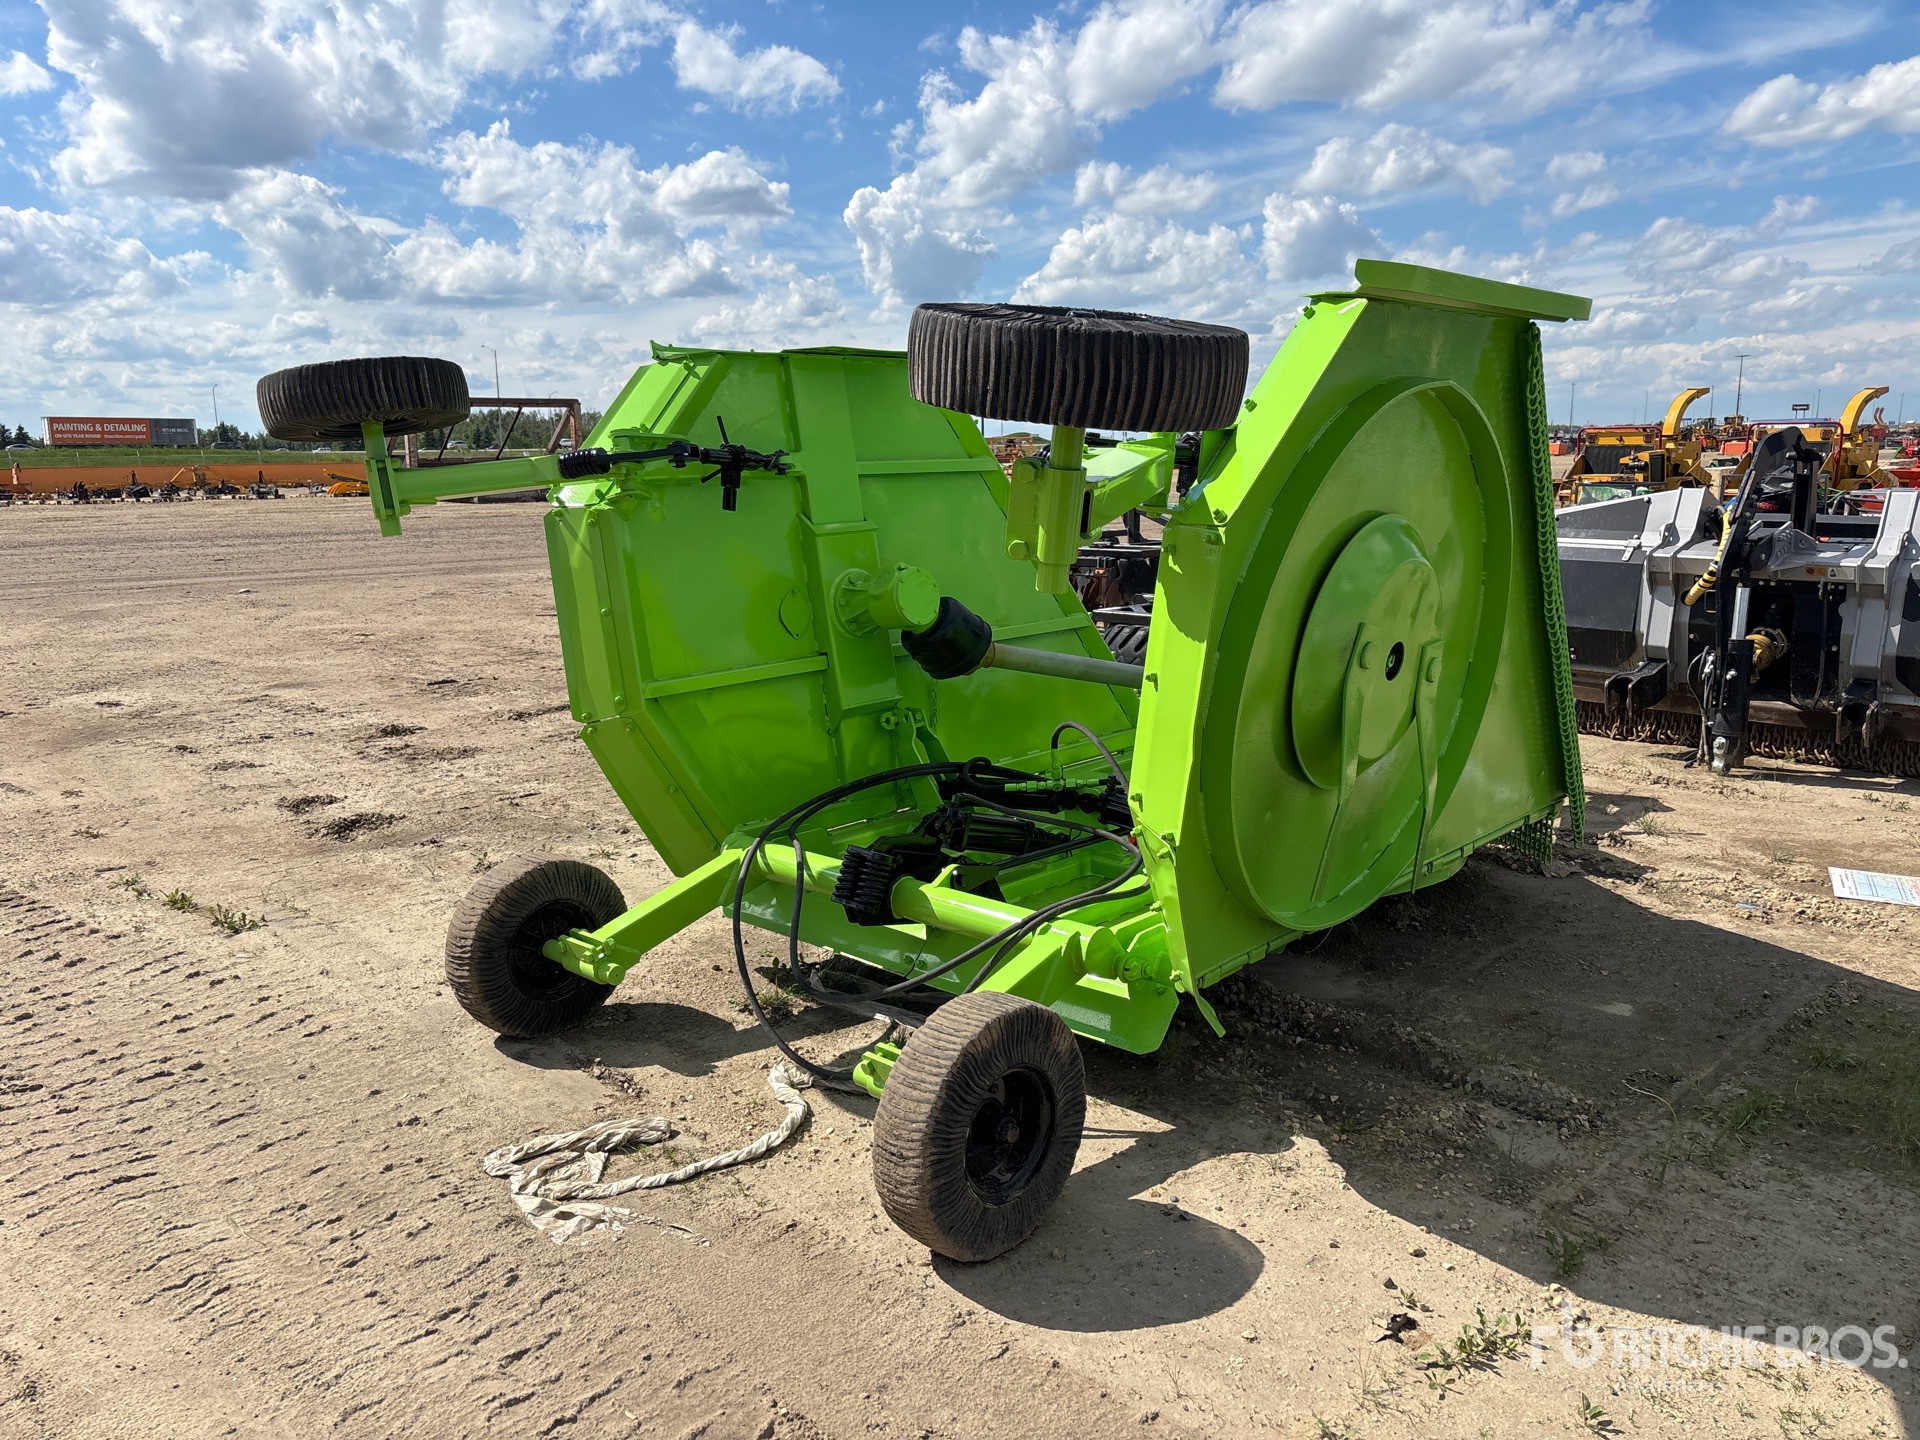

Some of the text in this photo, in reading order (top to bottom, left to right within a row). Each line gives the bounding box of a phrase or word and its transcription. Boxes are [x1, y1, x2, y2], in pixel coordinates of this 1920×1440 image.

[53, 423, 94, 431] PAINTING
[95, 423, 102, 431] &
[104, 423, 146, 432] DETAILING
